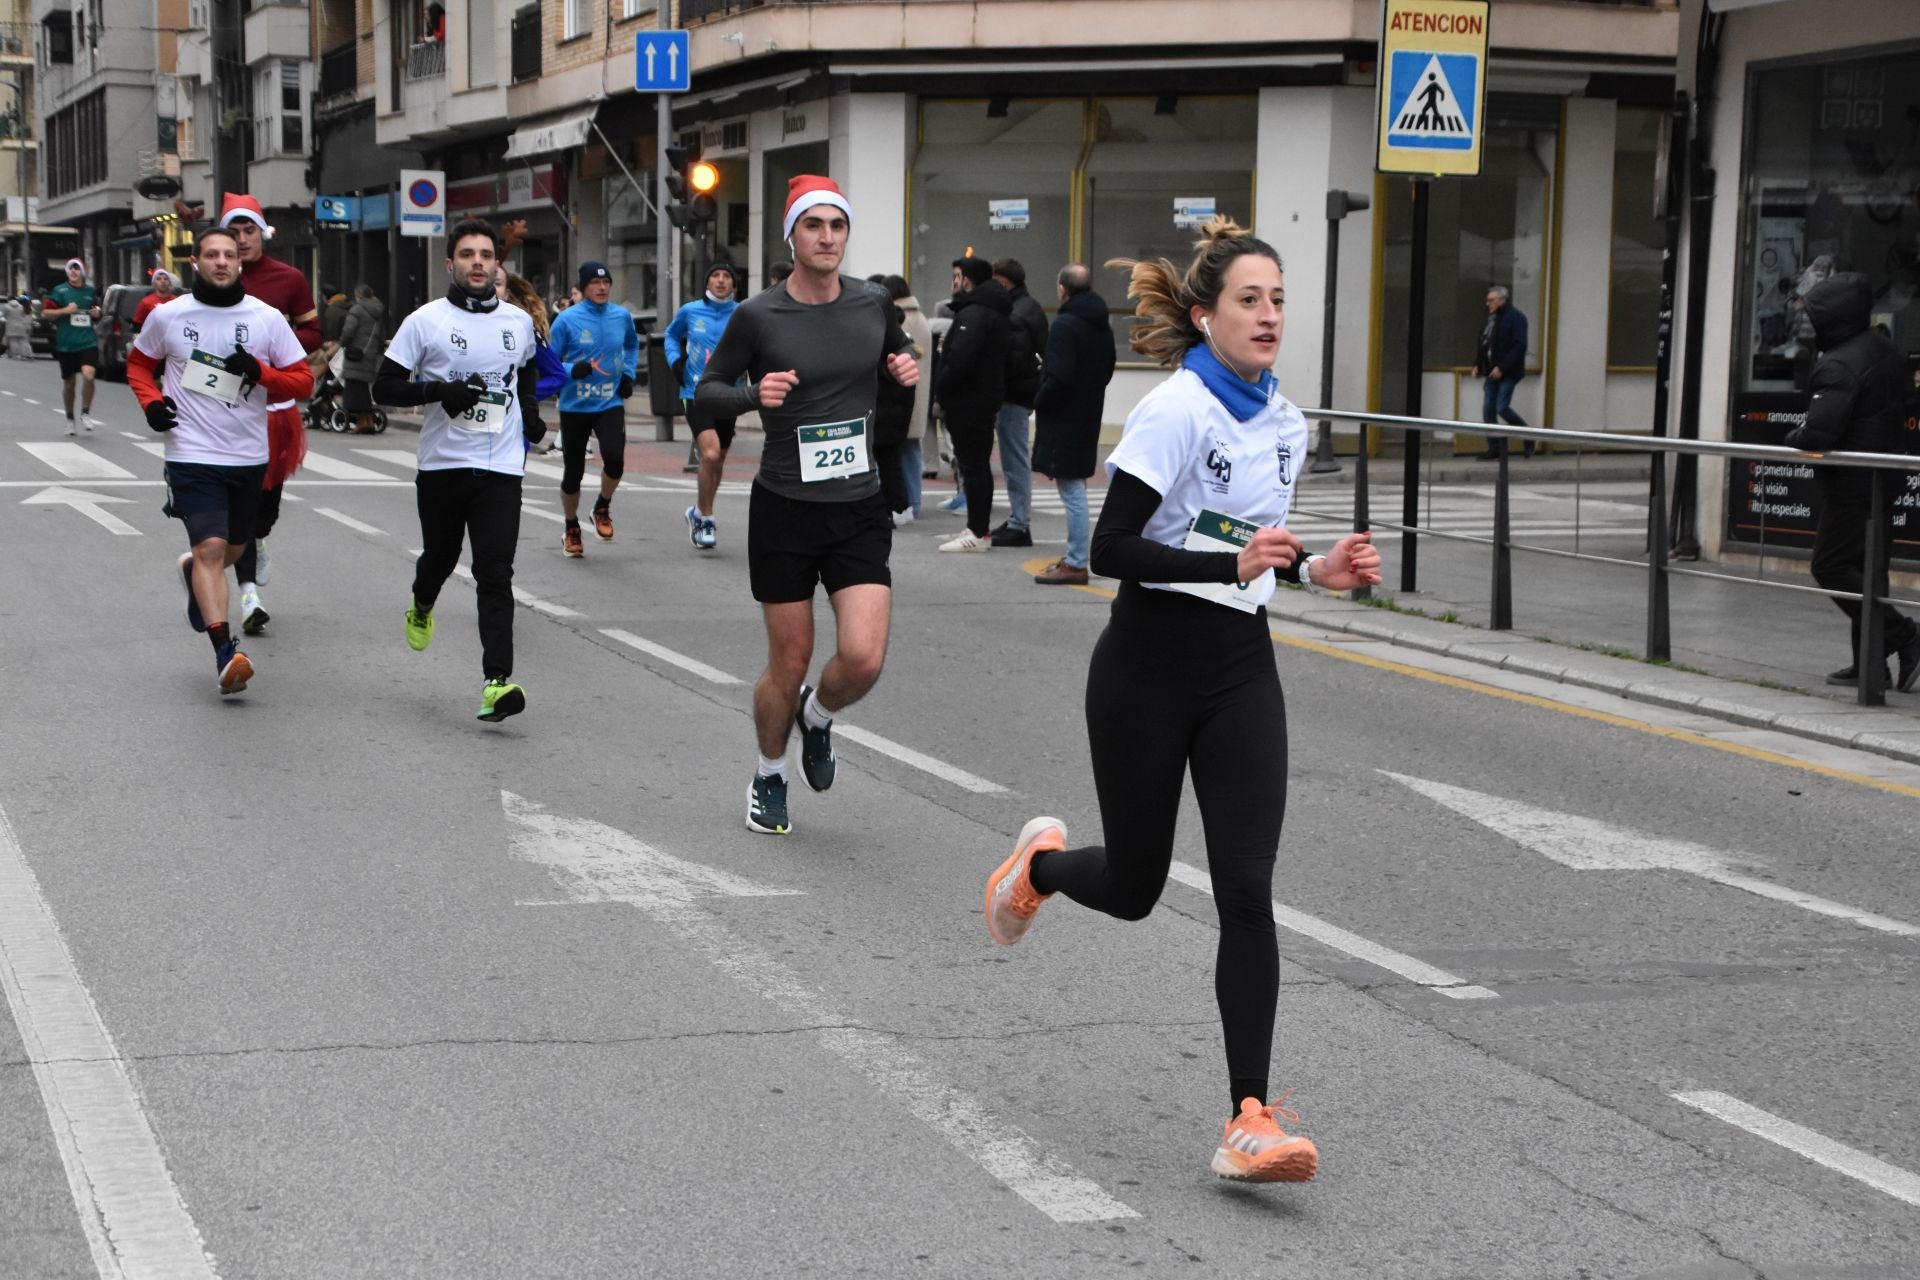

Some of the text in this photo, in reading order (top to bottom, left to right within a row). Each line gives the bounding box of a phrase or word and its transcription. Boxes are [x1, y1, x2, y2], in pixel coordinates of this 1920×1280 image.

[1391, 11, 1482, 34] ATENCION
[204, 373, 218, 388] 2
[815, 445, 856, 469] 226
[1765, 482, 1789, 496] visión
[1903, 491, 1915, 507] de
[1771, 503, 1811, 517] especiales
